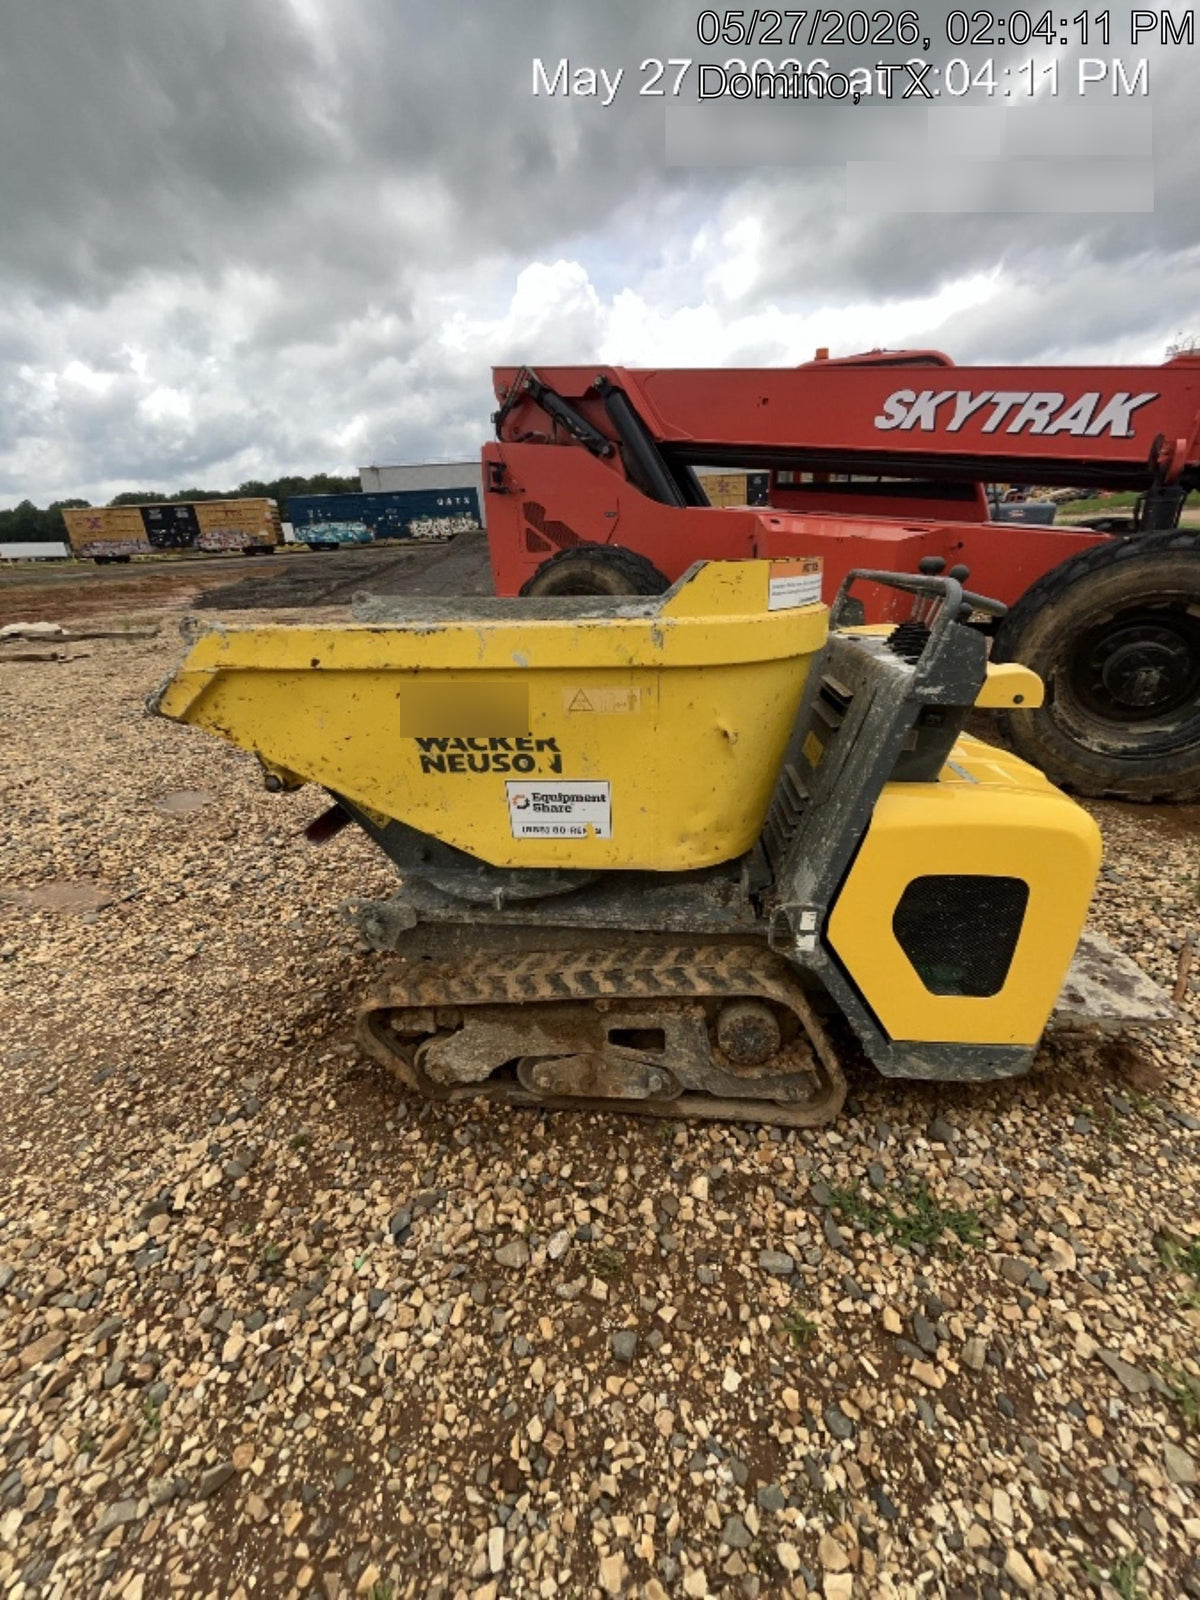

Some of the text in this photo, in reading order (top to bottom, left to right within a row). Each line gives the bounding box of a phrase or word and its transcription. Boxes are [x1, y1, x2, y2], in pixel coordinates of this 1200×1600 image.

[874, 389, 1159, 437] SKYTRAK
[531, 792, 607, 804] Equipment
[532, 803, 573, 813] Share
